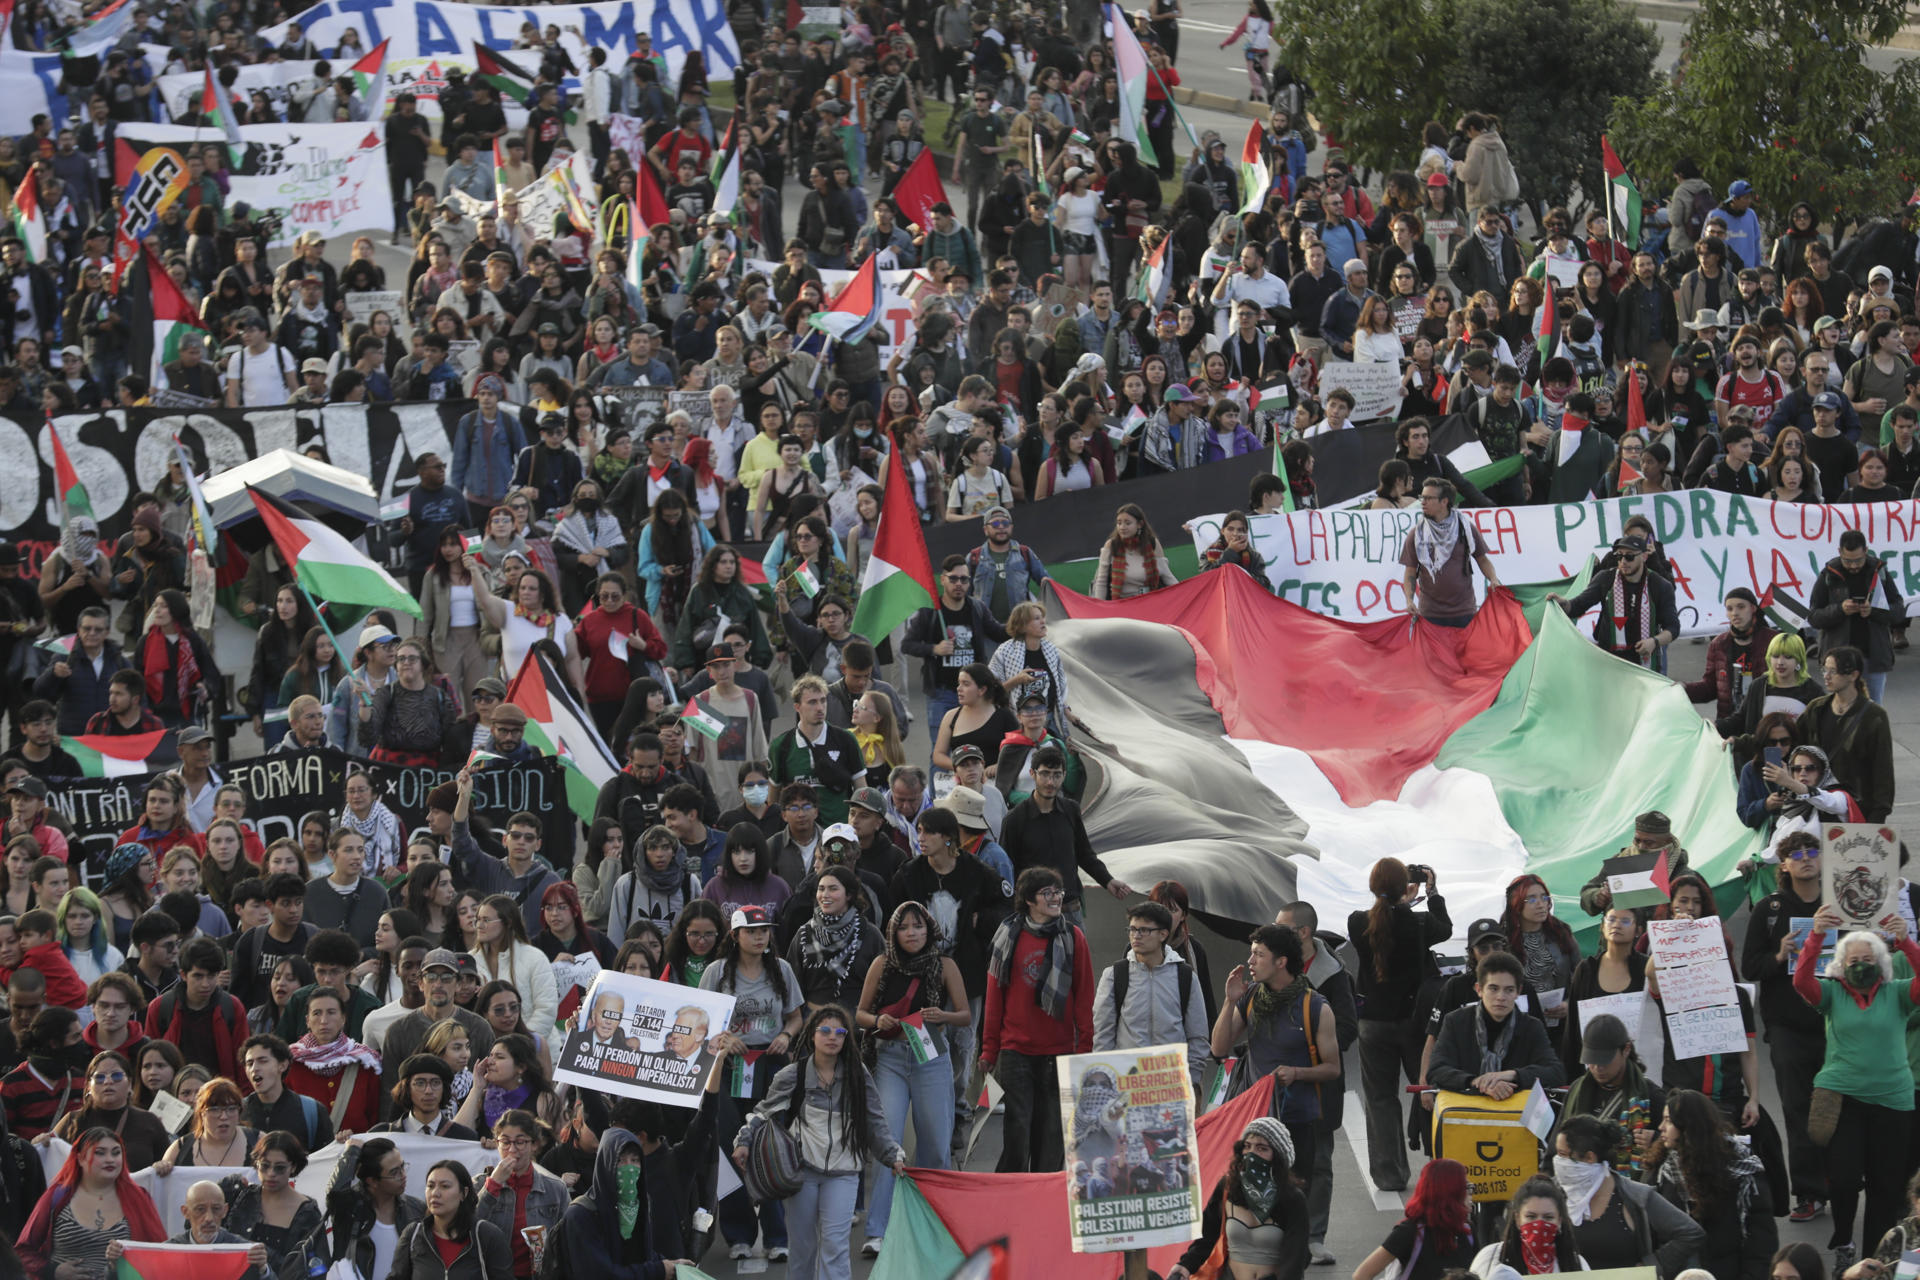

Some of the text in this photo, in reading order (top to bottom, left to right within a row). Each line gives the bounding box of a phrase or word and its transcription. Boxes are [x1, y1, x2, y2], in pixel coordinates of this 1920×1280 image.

[580, 0, 736, 74] MAR
[1287, 511, 1329, 566] LA
[228, 755, 324, 800] FORMA
[633, 1014, 663, 1031] 67.144
[630, 1028, 660, 1041] PALESTINOS
[593, 1046, 605, 1058] NI
[605, 1048, 640, 1066] PERDÓN
[642, 1055, 653, 1068] NI
[1140, 1052, 1184, 1073] VIVA LA
[574, 1054, 600, 1071] PARA
[636, 1067, 696, 1089] IMPERIALISTA
[1131, 1086, 1189, 1106] NACIONAL
[1489, 1166, 1521, 1177] Food
[1074, 1191, 1193, 1219] PALESTINA RESISTE
[1076, 1214, 1146, 1235] PALESTINA
